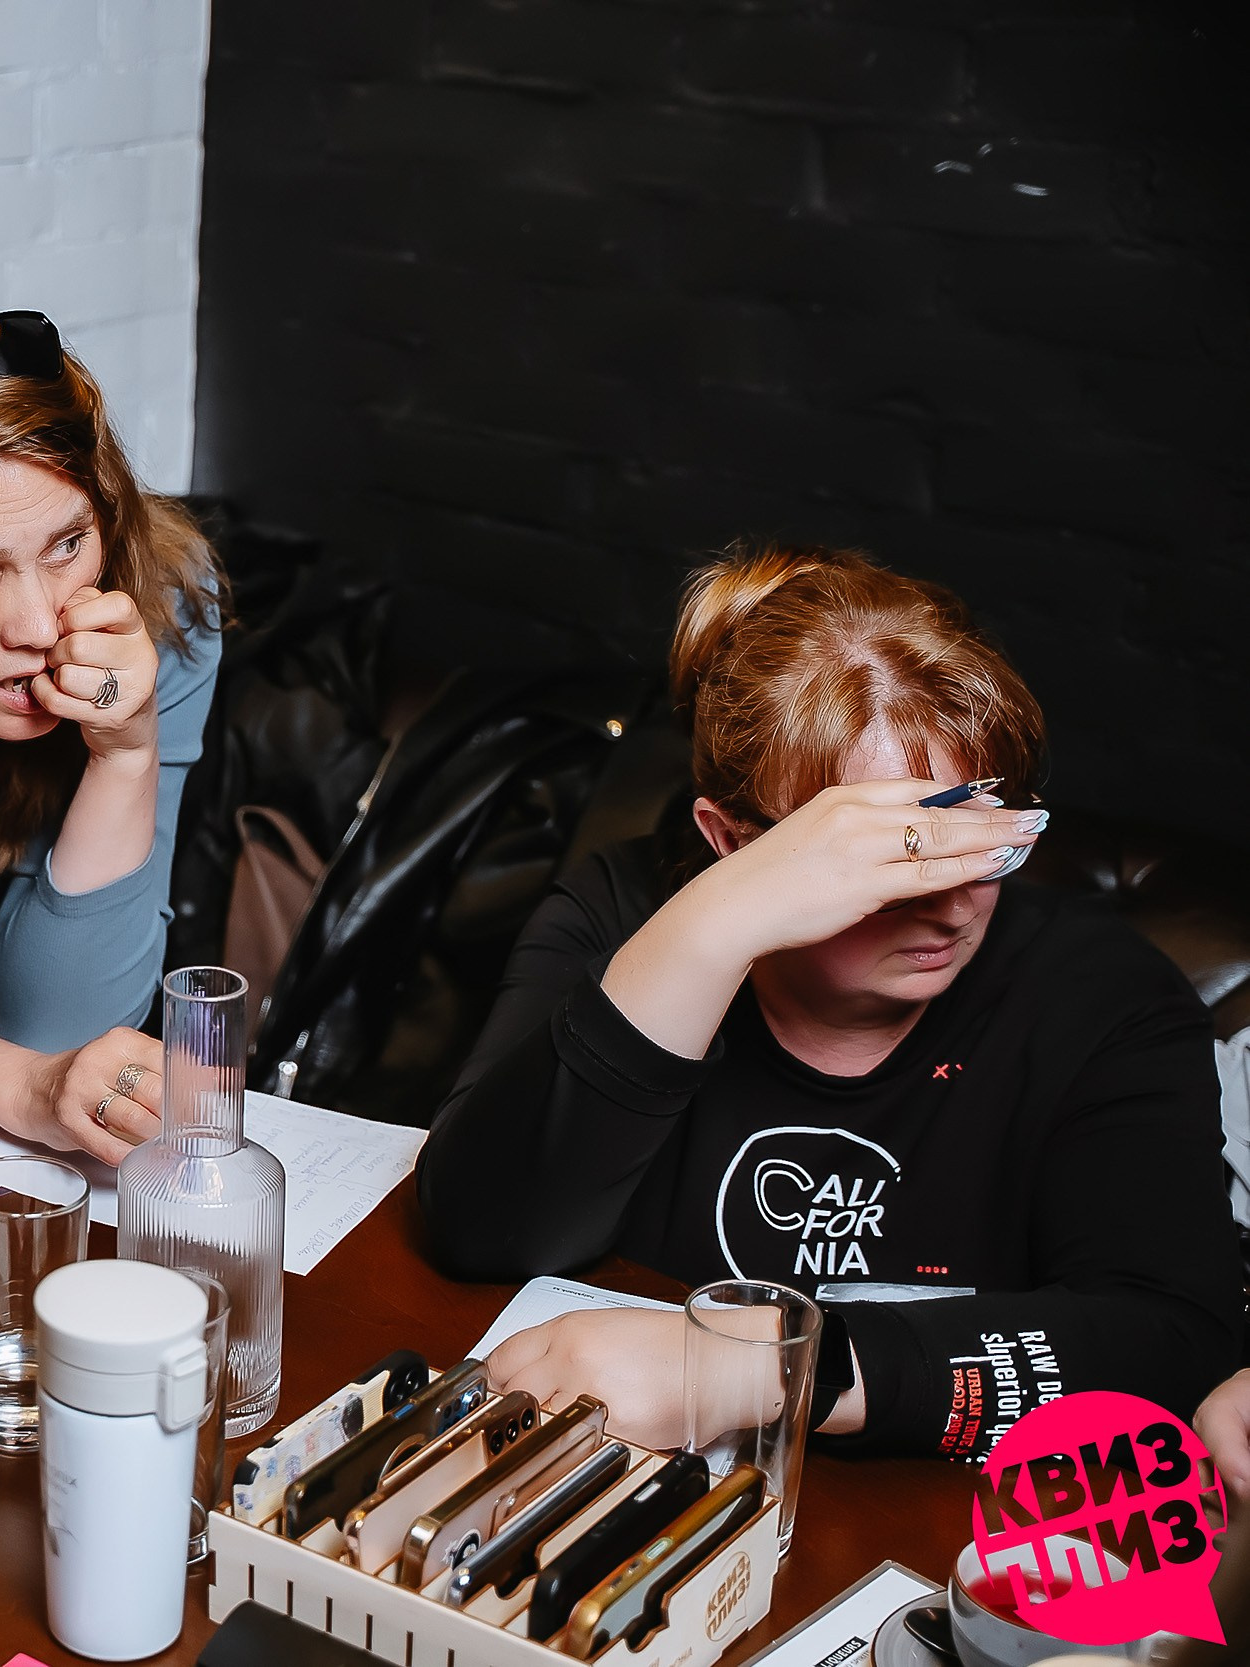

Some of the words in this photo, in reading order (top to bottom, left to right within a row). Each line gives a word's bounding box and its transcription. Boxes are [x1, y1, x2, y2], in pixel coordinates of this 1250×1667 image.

[801, 1204, 885, 1240] FOR
[793, 1241, 870, 1276] NIA
[1017, 1330, 1060, 1374] RAW
[949, 1332, 1029, 1419] superior
[965, 1367, 983, 1417] URBAN
